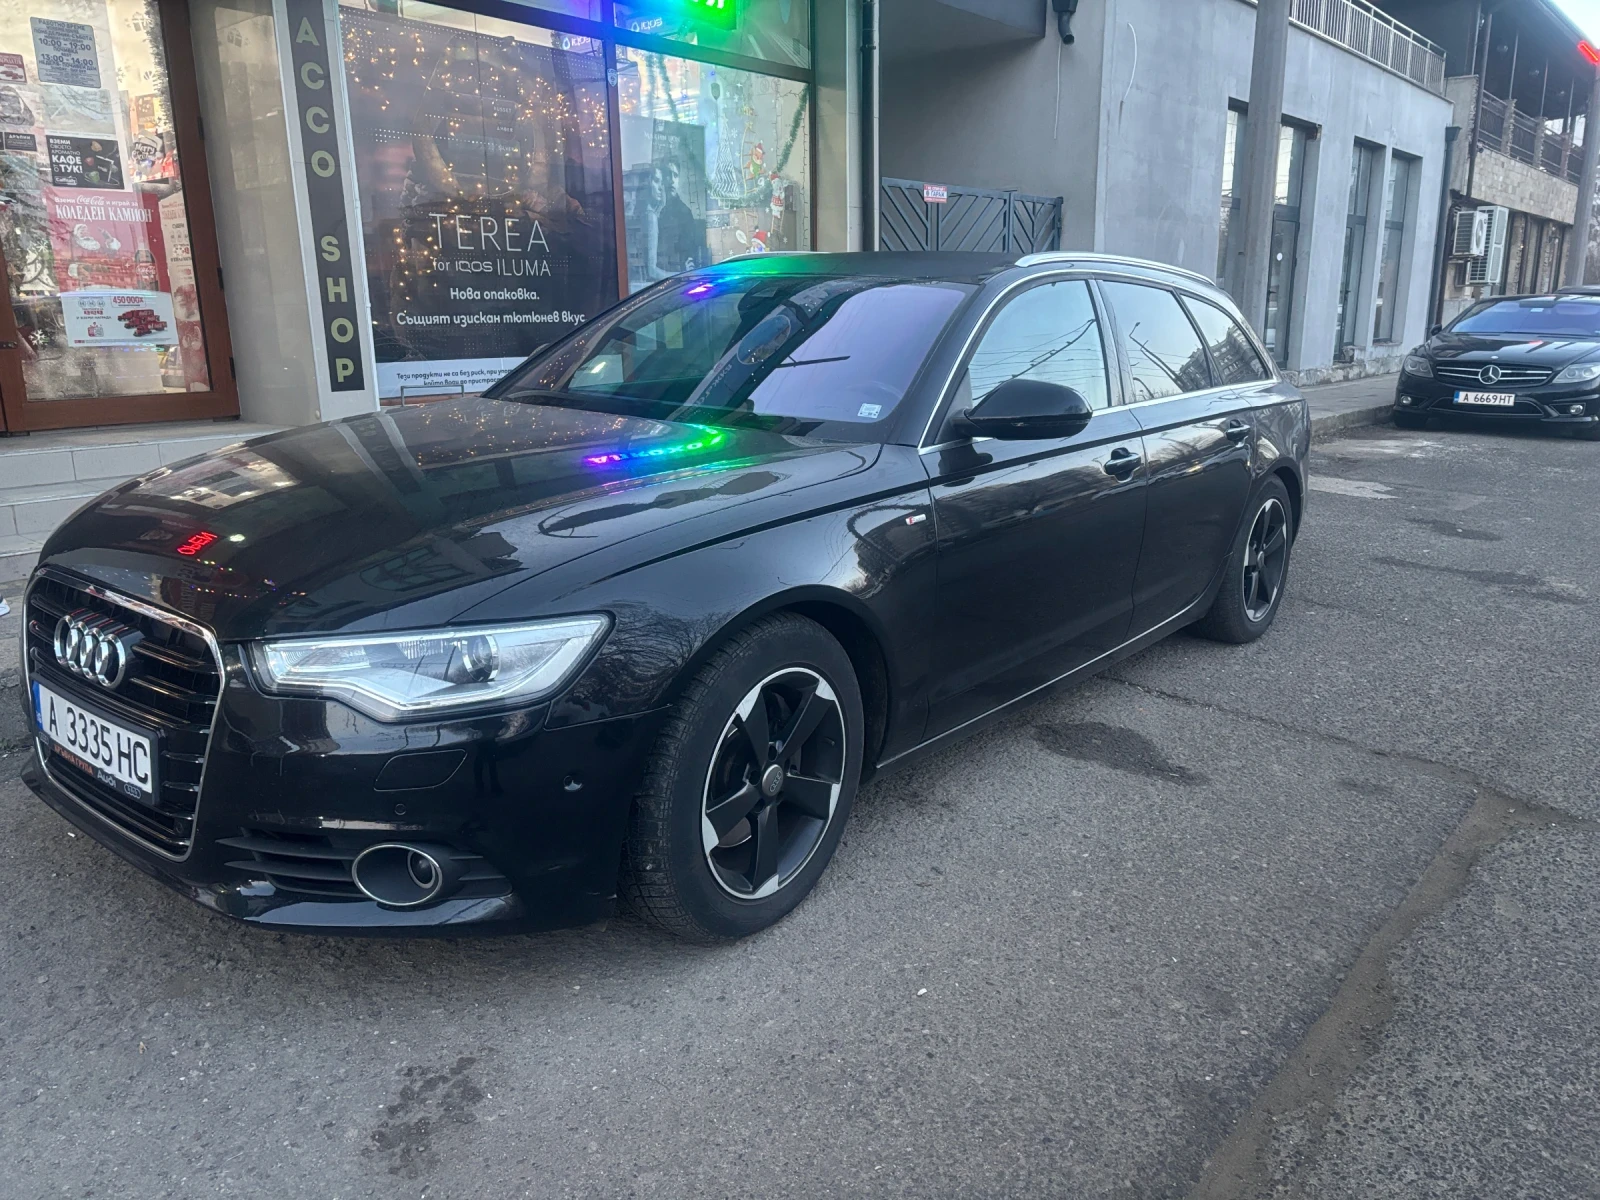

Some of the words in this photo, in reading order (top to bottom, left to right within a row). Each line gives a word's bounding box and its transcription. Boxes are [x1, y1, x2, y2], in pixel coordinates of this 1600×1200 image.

[39, 38, 62, 47] 10:00
[69, 41, 91, 51] 19:00
[41, 53, 64, 63] 13:00
[71, 57, 93, 66] 14:00
[51, 154, 83, 165] КАФЕ
[59, 164, 83, 174] ТУК!
[55, 204, 106, 222] КОЛЕДЕН
[428, 213, 549, 252] TEREA
[432, 258, 451, 271] for
[455, 260, 493, 273] IQOS
[497, 258, 551, 276] ILUMA
[450, 287, 481, 300] Нова
[483, 287, 540, 300] опаковка.
[396, 312, 450, 326] Същият
[453, 312, 500, 327] изискан
[503, 311, 559, 324] тютюнев
[562, 310, 586, 325] вкус
[411, 372, 443, 380] продукти
[459, 369, 471, 378] без
[1463, 393, 1469, 402] A
[49, 696, 59, 737] A
